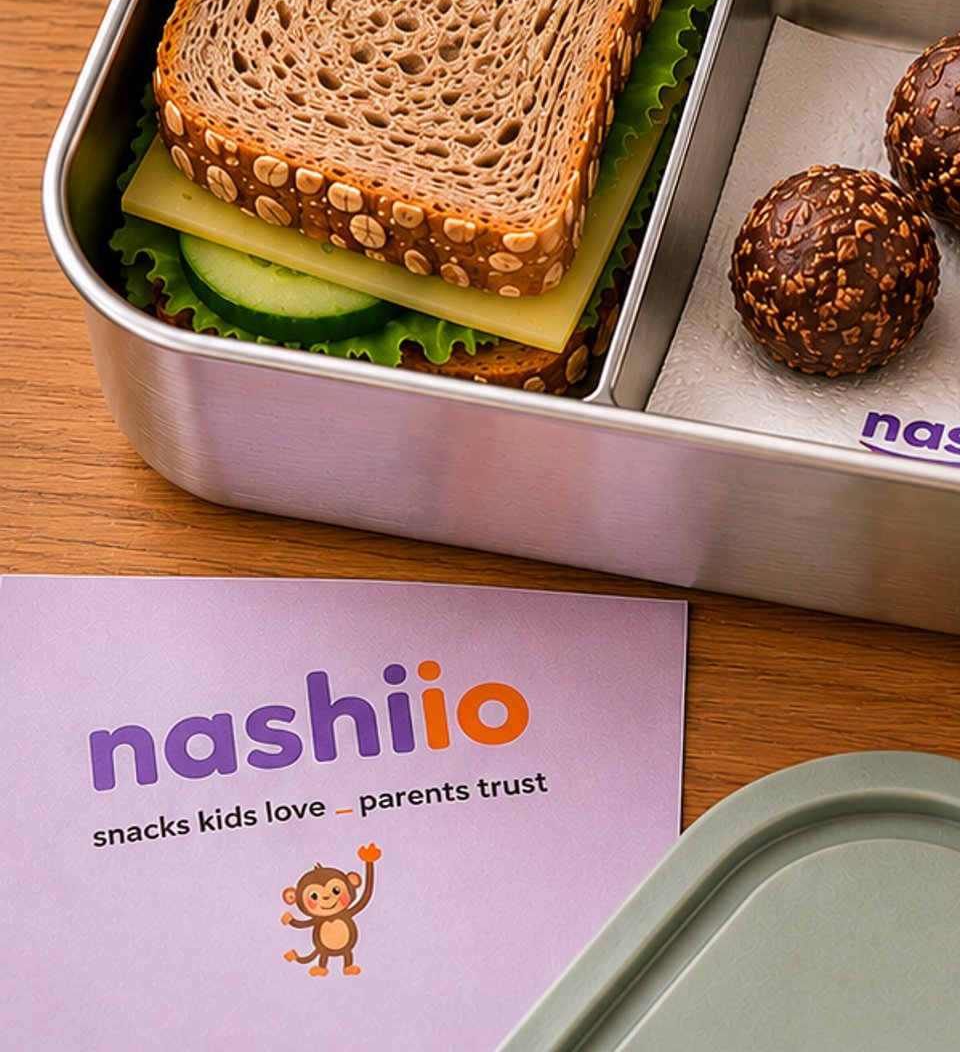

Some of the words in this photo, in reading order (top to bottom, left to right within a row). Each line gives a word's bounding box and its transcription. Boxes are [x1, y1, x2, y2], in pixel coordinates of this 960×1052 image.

[88, 659, 531, 792] nashiio
[92, 814, 191, 848] snacks
[198, 804, 258, 833] kids
[265, 797, 327, 823] love
[358, 781, 470, 818] parents
[477, 771, 549, 798] trust
